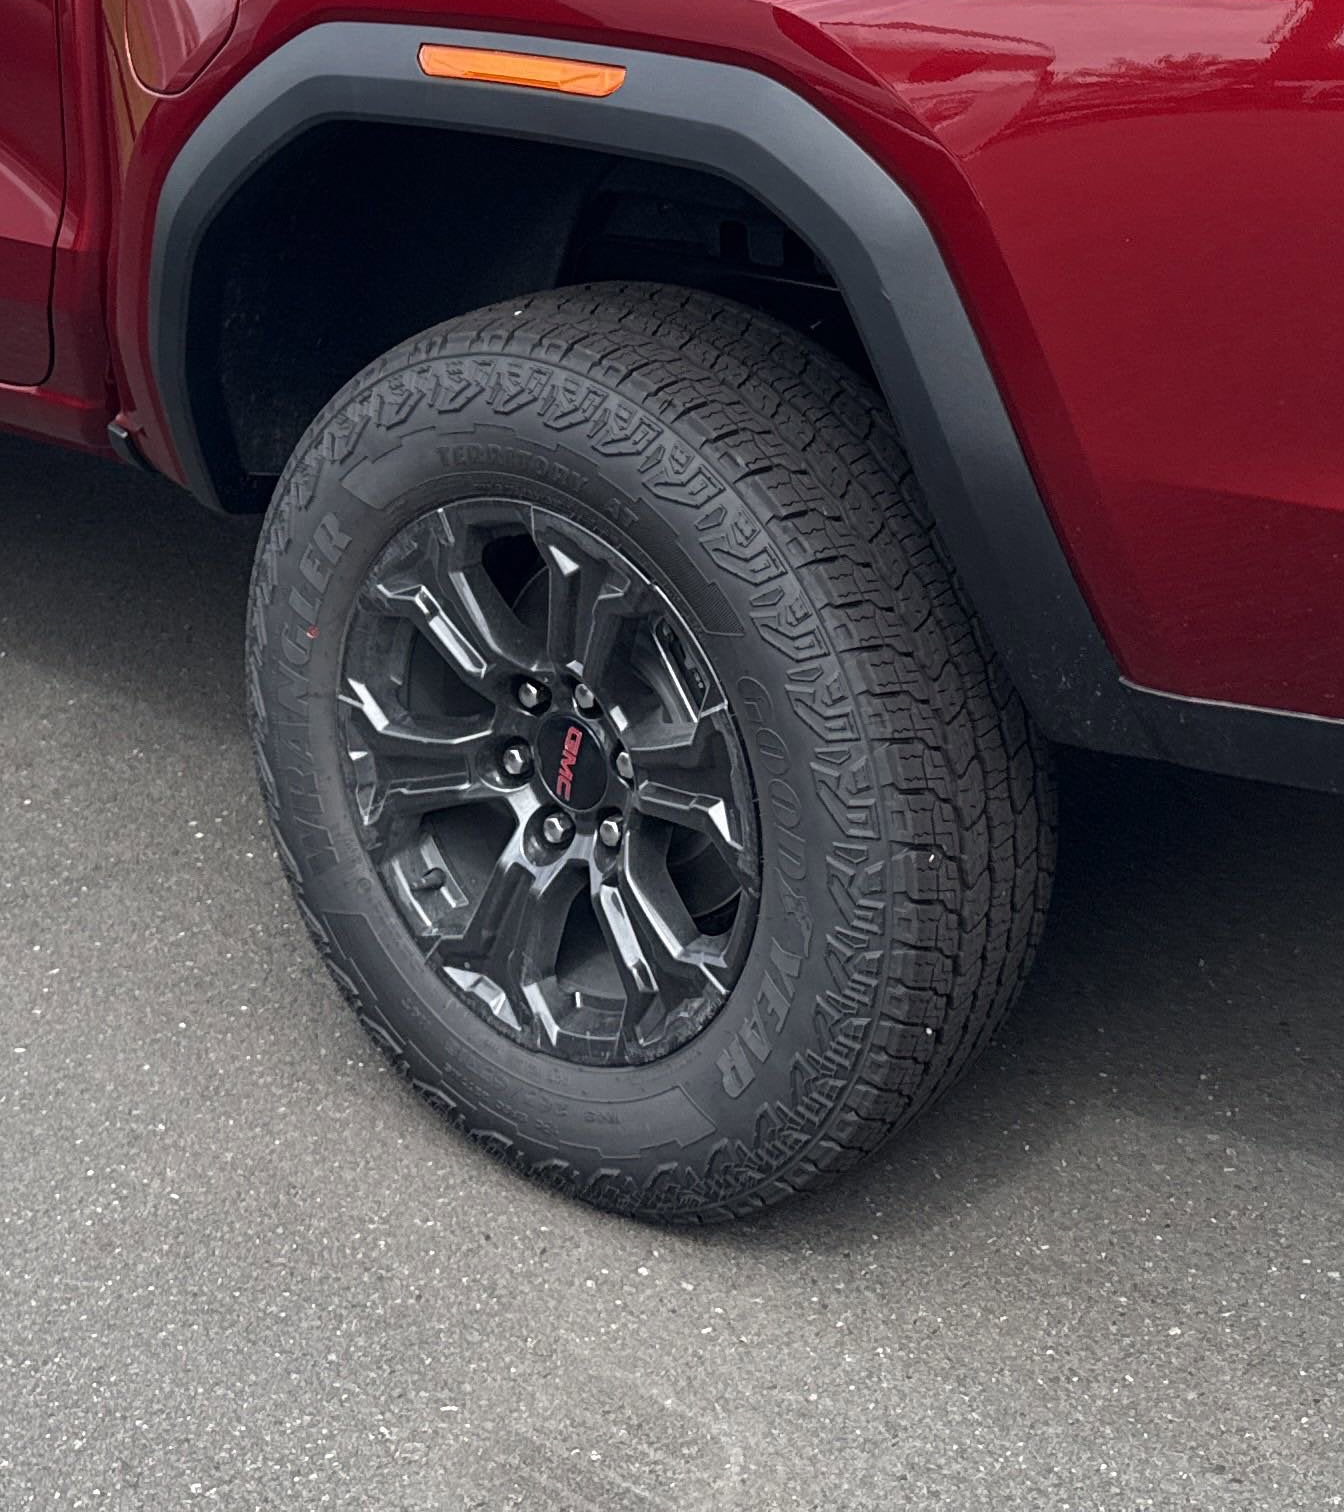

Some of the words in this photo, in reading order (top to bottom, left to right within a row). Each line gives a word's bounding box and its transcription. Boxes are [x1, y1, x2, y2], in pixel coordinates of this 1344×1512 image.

[436, 443, 590, 494] TERRITORY
[278, 512, 354, 876] WRANGLER
[556, 726, 583, 801] GMC
[716, 675, 816, 1100] GOODYEAR
